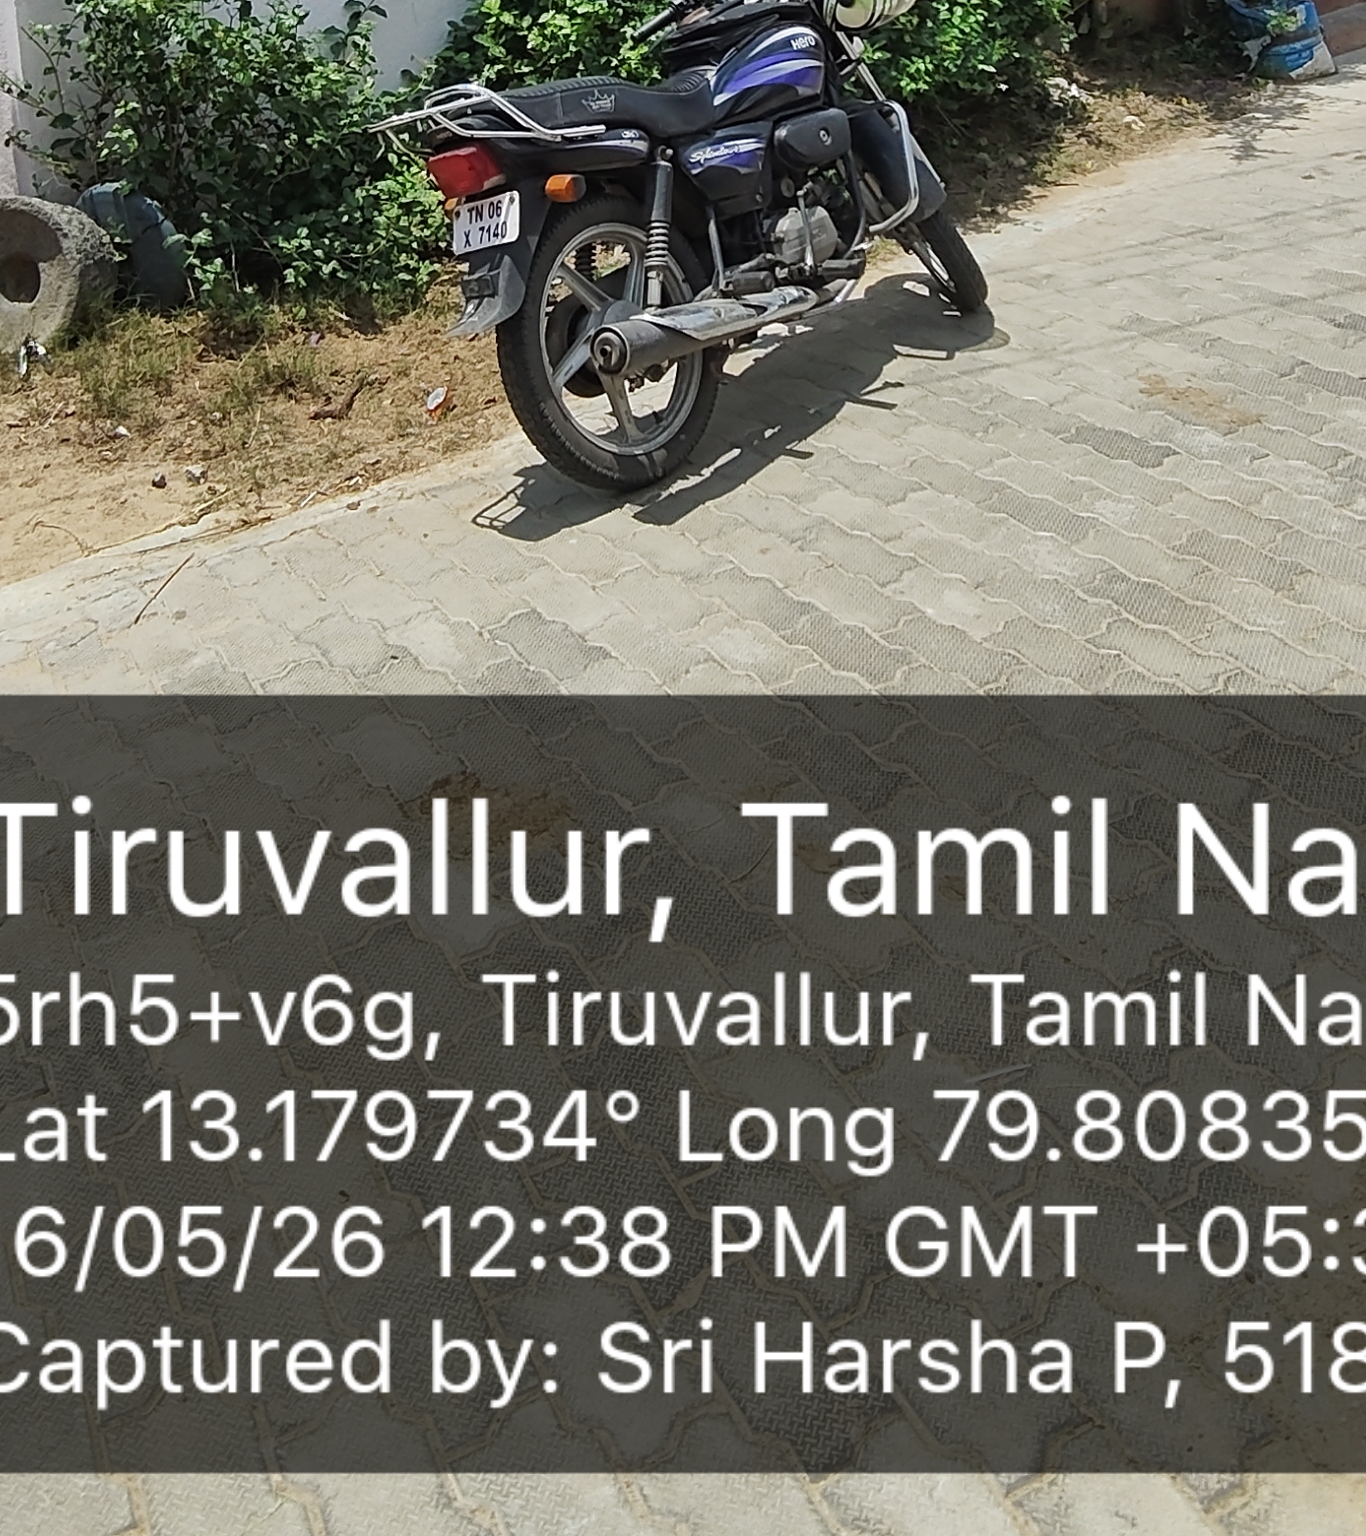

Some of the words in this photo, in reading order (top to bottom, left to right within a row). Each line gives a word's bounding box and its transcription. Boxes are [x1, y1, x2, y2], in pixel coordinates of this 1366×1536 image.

[790, 35, 816, 51] Hero
[467, 204, 484, 224] TN
[488, 200, 502, 219] 06
[464, 230, 472, 248] X
[478, 221, 507, 244] 7140
